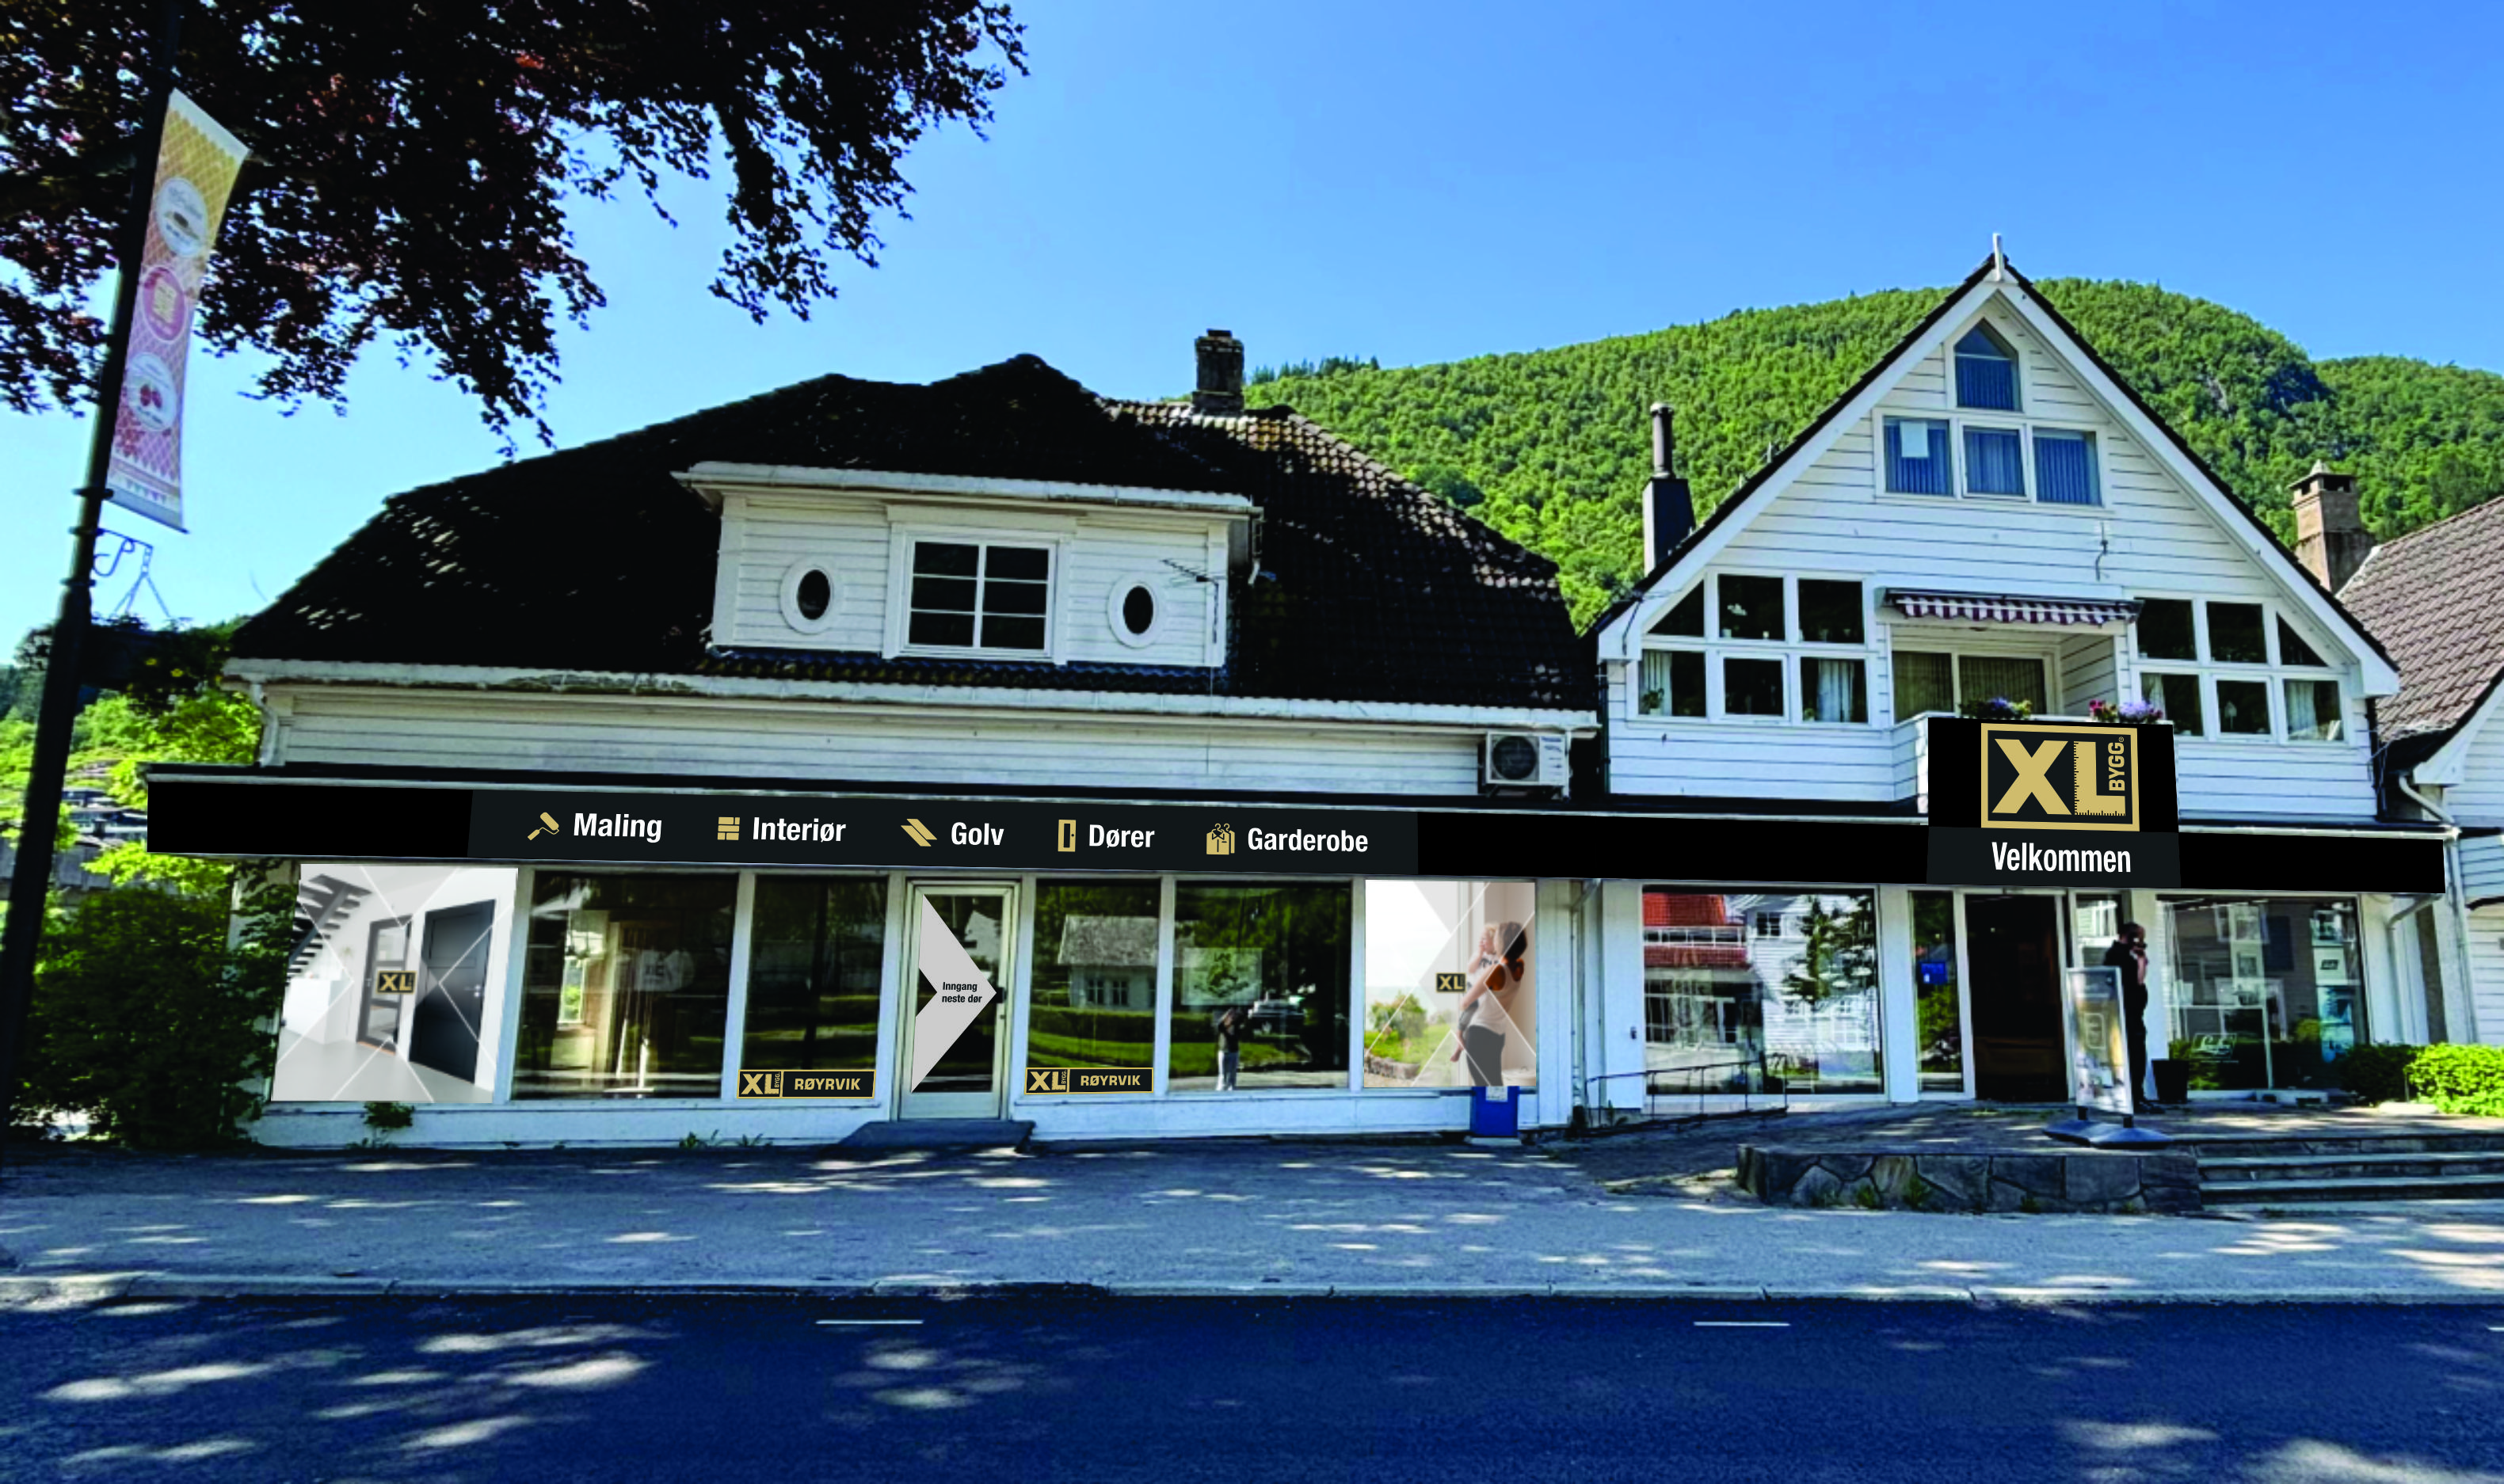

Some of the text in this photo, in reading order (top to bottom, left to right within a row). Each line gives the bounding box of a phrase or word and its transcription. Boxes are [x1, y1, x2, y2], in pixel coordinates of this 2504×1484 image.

[1991, 738, 2126, 816] XL
[2107, 742, 2125, 791] BYGG
[574, 812, 662, 843] Maling
[753, 816, 847, 843] Interiør
[951, 821, 1004, 846] Golv
[1088, 824, 1155, 849] Dører
[1248, 827, 1368, 853] Garderobe
[1991, 841, 2131, 873] Velkommen
[380, 974, 412, 991] XL
[943, 981, 978, 992] Inngang
[1439, 975, 1464, 990] XL
[942, 994, 983, 1003] neste dør
[741, 1073, 780, 1095] XL
[794, 1078, 861, 1090] RØYRVIK
[1027, 1071, 1066, 1091] XL
[1080, 1075, 1141, 1086] RØYRVIK
